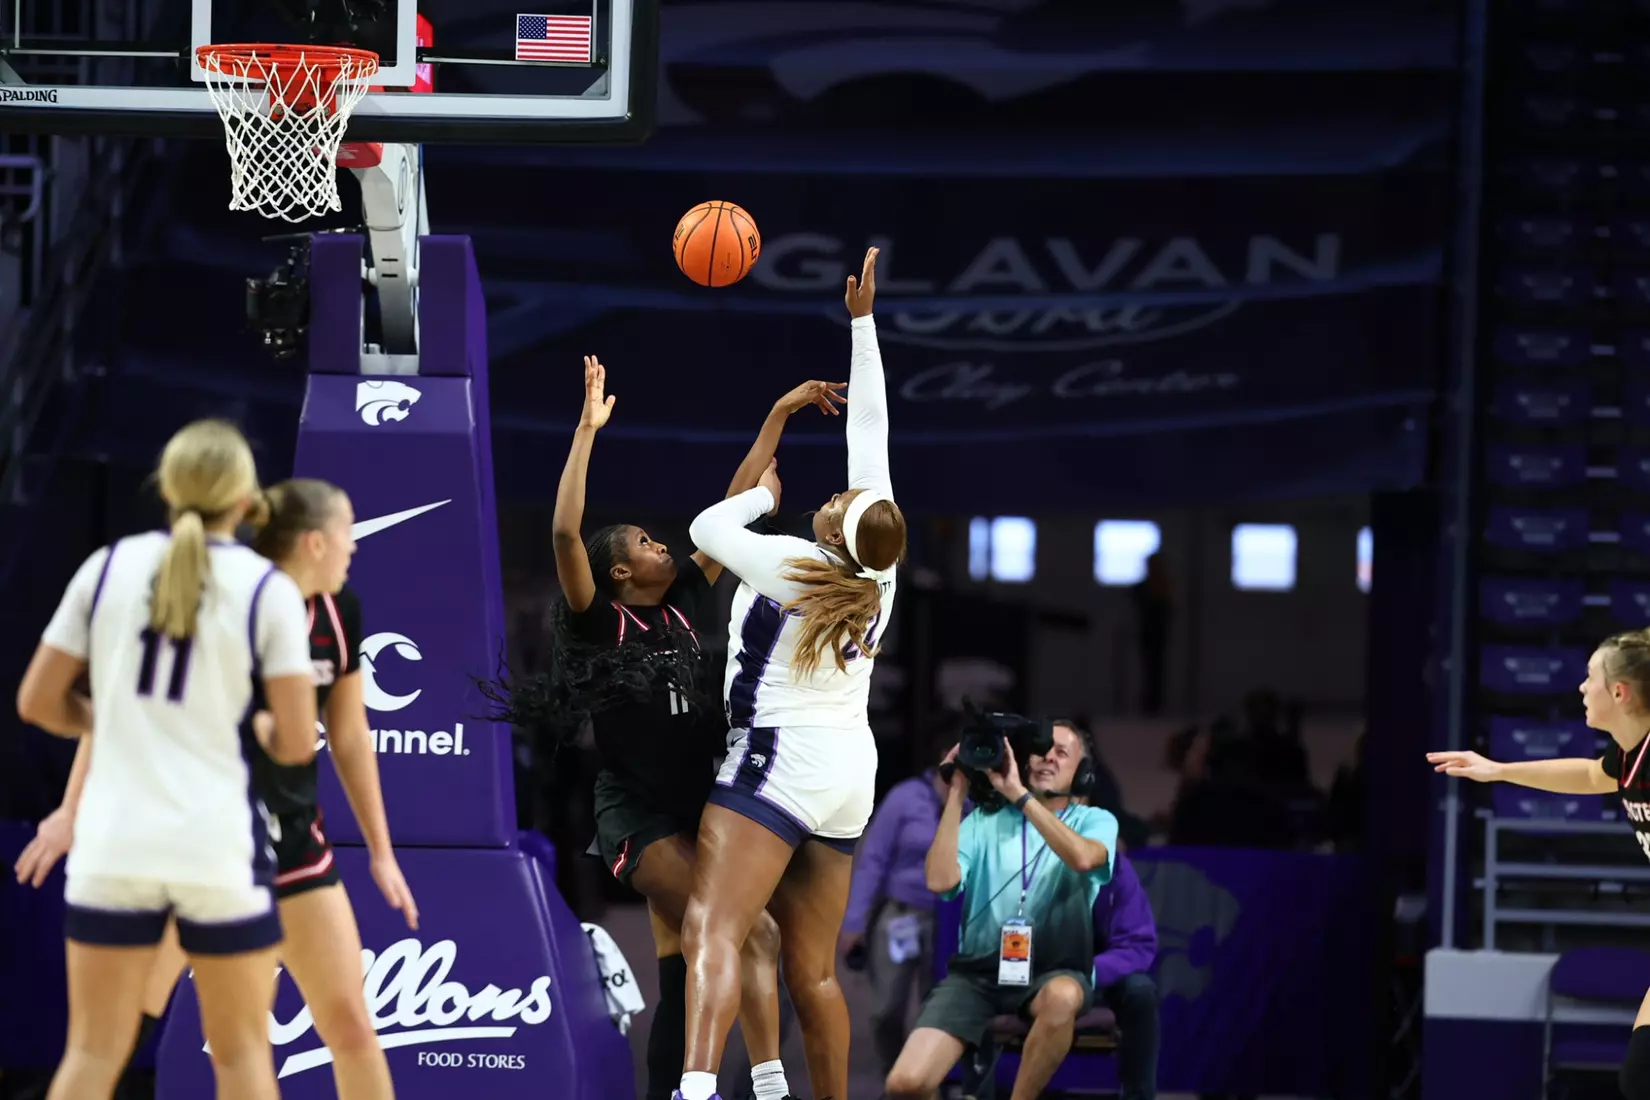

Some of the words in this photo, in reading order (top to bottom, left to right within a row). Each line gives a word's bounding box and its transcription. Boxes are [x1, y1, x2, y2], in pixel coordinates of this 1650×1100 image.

[0, 89, 58, 103] PALDING
[751, 231, 1342, 292] GLAVAN
[136, 626, 193, 701] 11
[268, 938, 552, 1045] llons
[417, 1051, 464, 1068] FOOD
[466, 1053, 527, 1070] STORES
